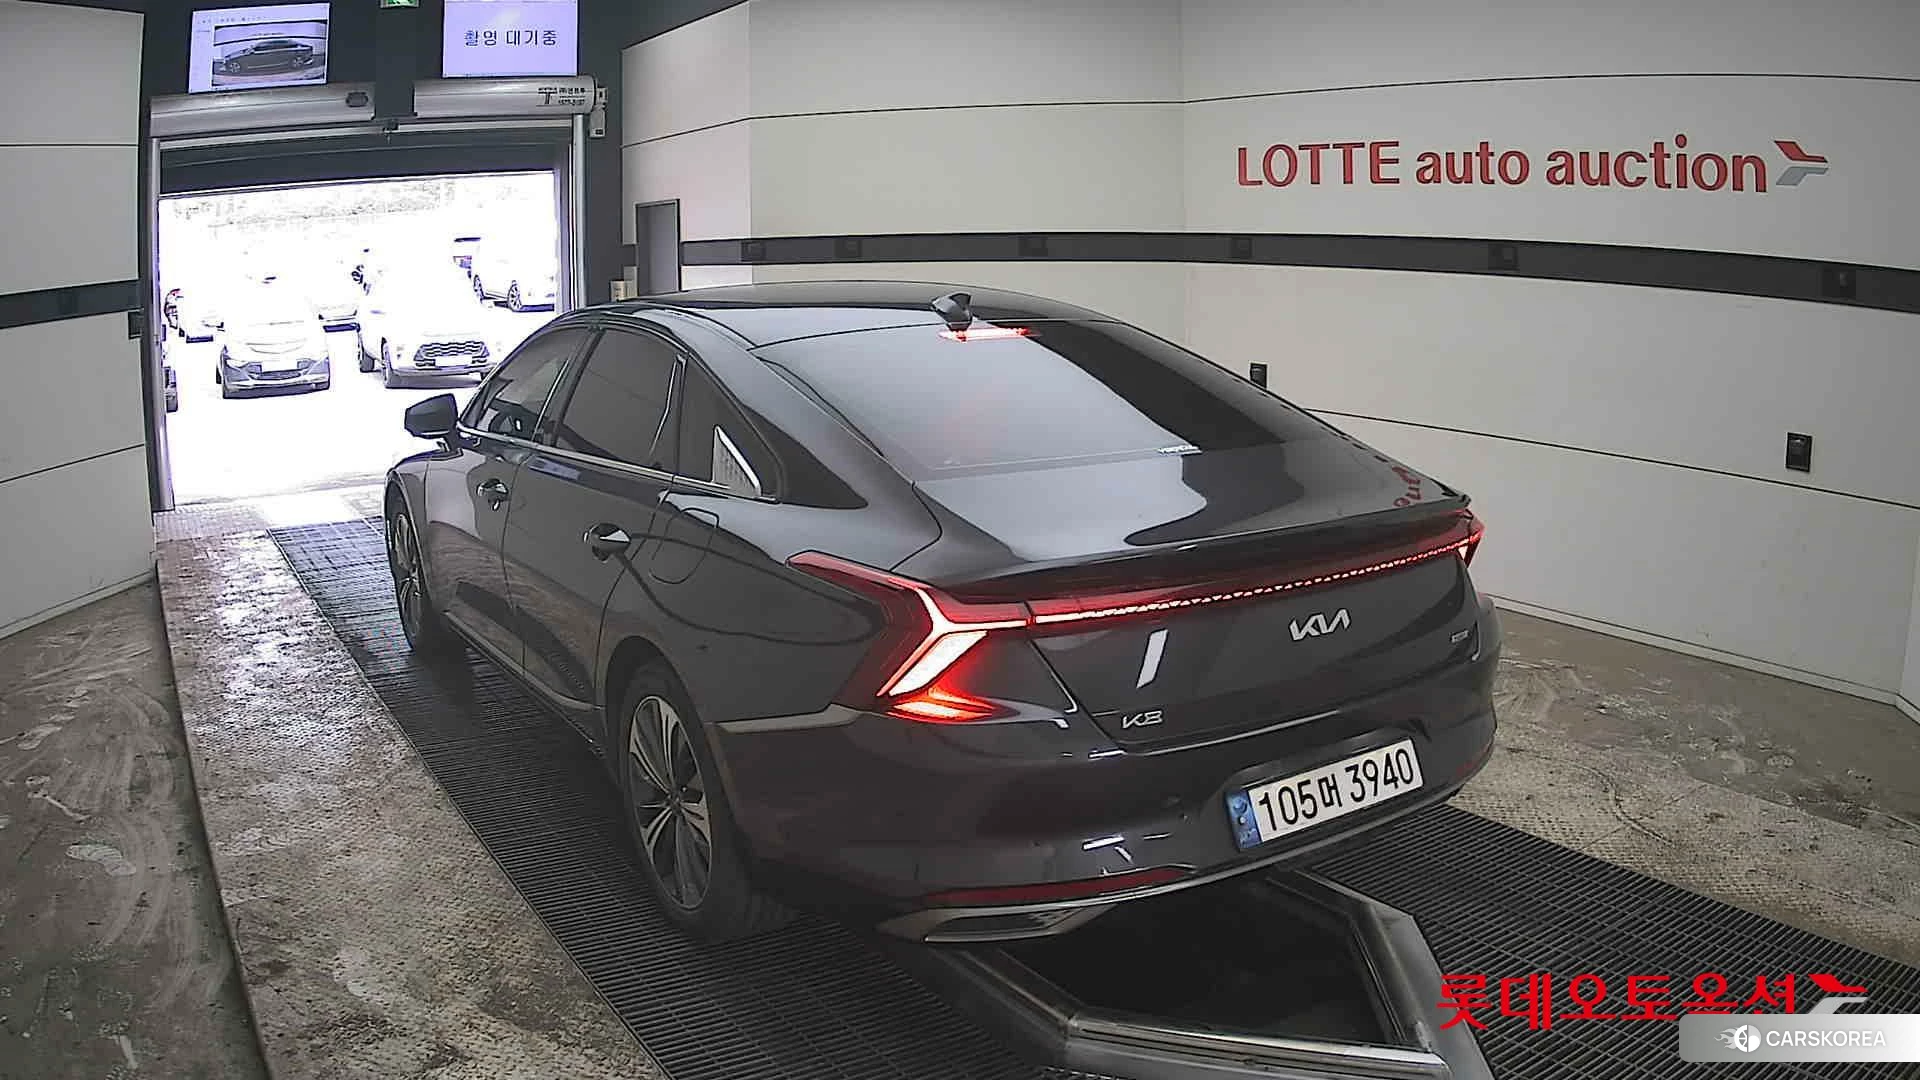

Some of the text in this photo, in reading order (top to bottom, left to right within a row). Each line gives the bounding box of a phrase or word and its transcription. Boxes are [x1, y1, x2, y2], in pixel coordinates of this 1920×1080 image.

[506, 30, 557, 46] 대기중
[1237, 134, 1767, 193] LOTTE auto auction
[1289, 608, 1350, 641] KIA
[1122, 710, 1162, 729] K8
[1259, 748, 1414, 831] 105머 3940
